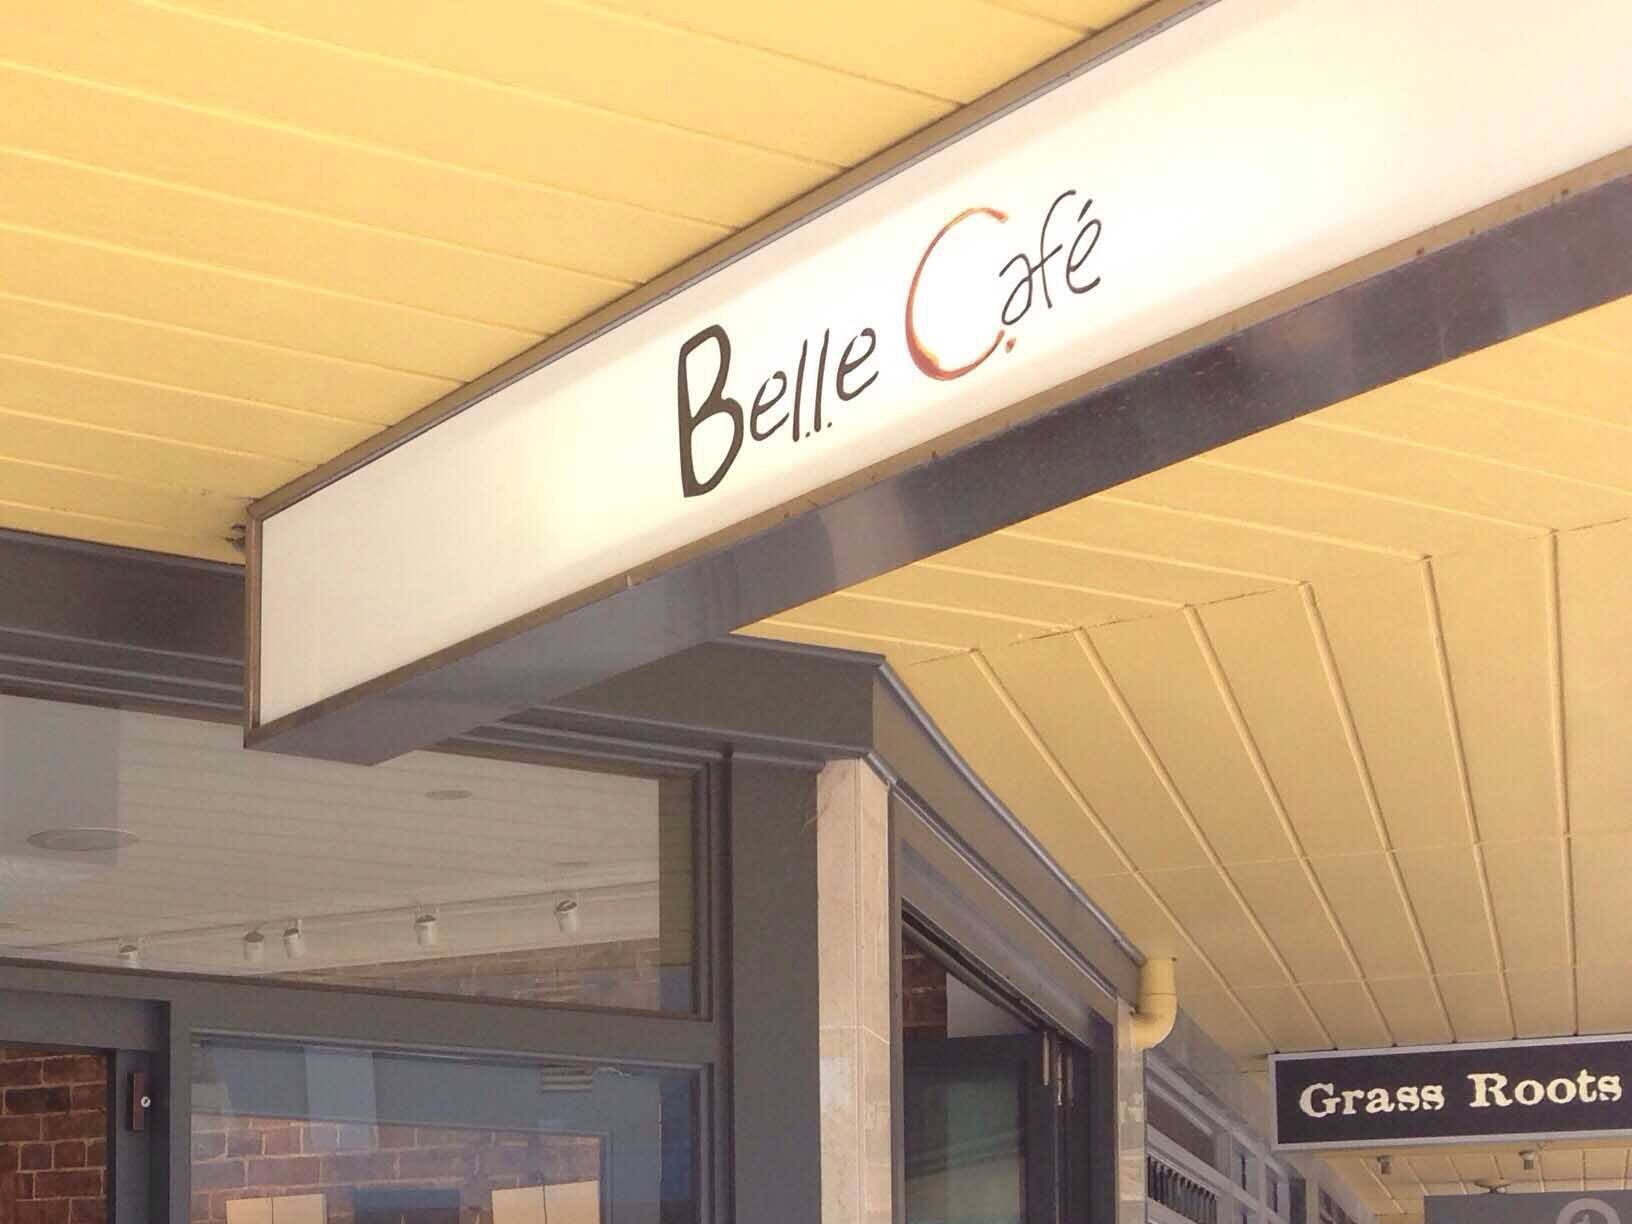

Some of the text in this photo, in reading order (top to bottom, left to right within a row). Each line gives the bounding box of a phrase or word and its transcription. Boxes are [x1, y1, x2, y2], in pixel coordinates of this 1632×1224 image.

[677, 189, 1103, 499] Belle Café
[1298, 1068, 1623, 1119] Grass Roots
